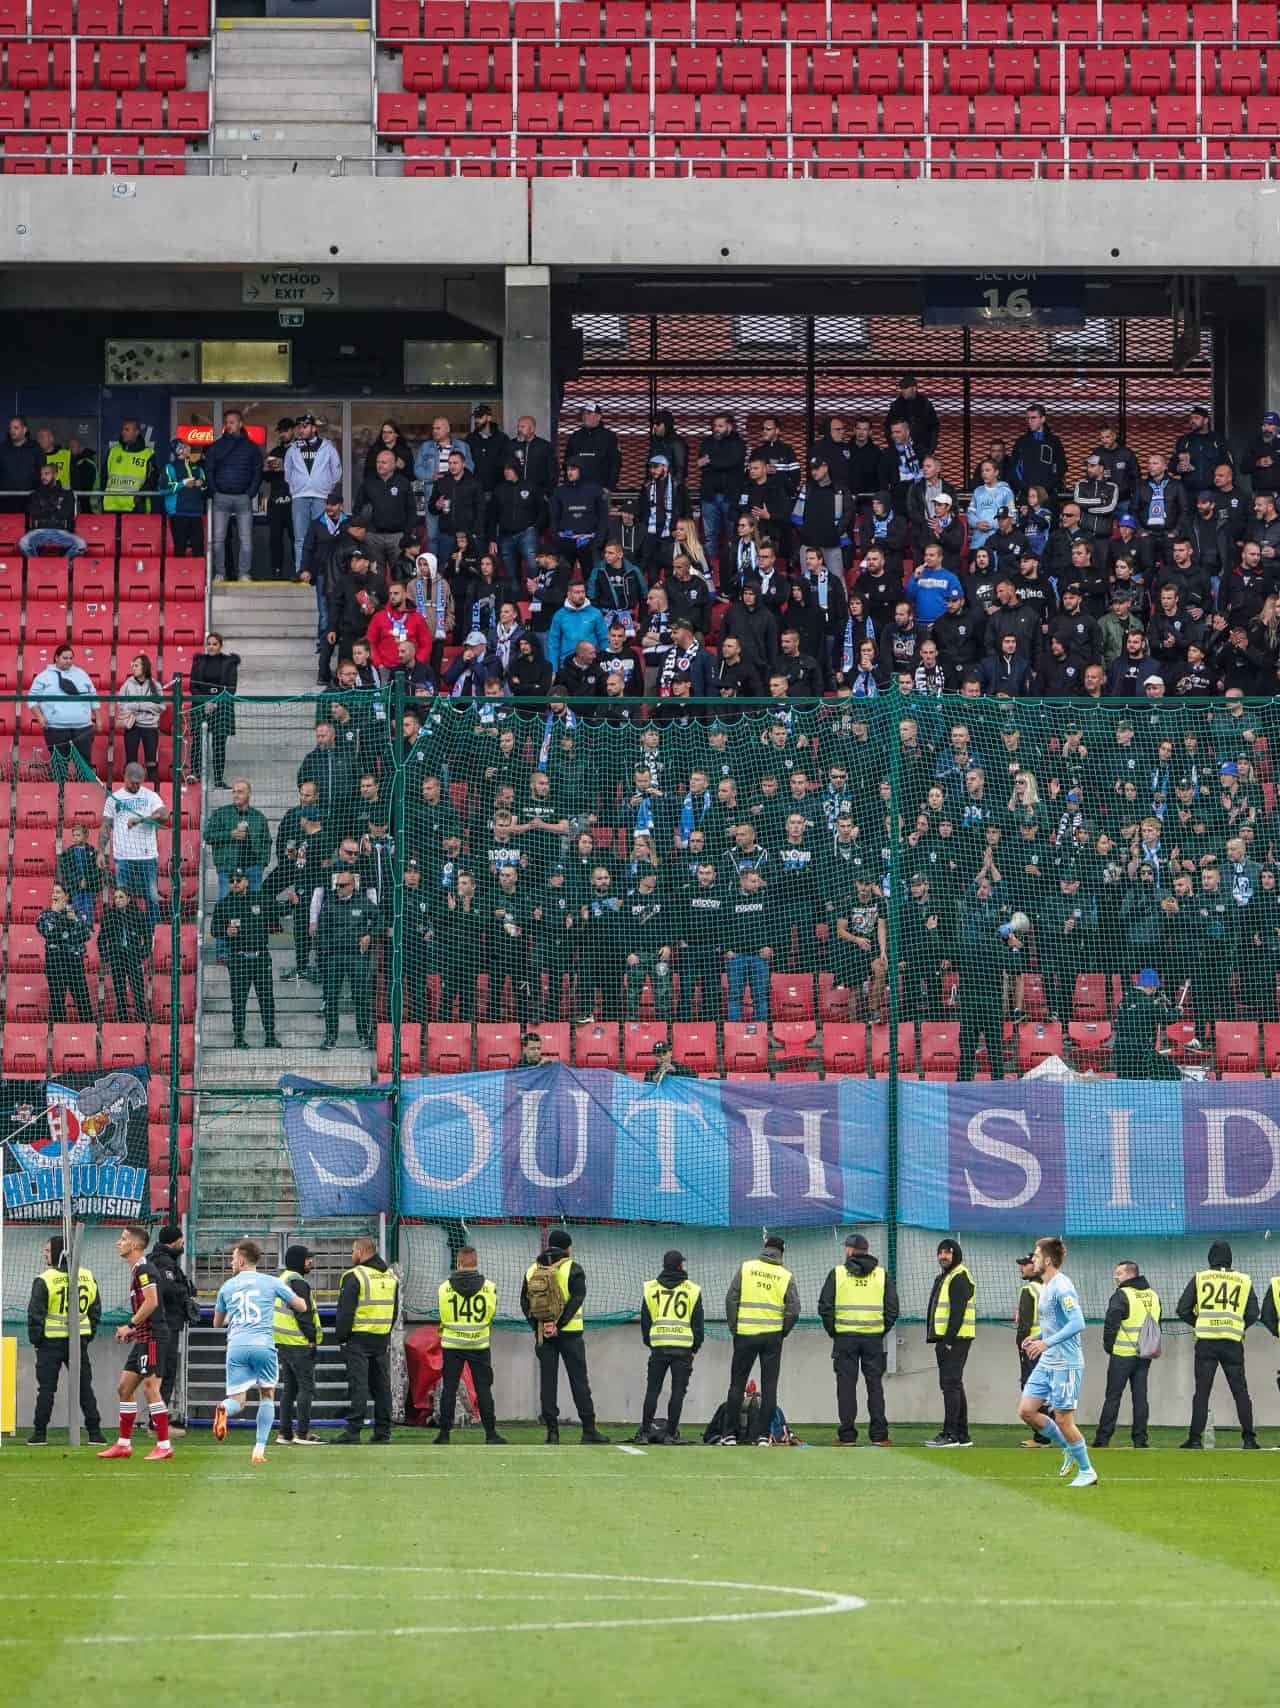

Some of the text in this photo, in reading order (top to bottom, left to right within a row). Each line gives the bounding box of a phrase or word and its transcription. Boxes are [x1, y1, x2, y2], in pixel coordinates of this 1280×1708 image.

[275, 288, 305, 299] EXIT
[983, 288, 1031, 318] 16
[302, 1089, 836, 1199] SOUTH
[750, 1269, 783, 1281] SECURITY
[56, 1285, 89, 1314] 16
[448, 1294, 487, 1323] 149
[652, 1290, 689, 1319] 176
[1200, 1282, 1242, 1312] 244
